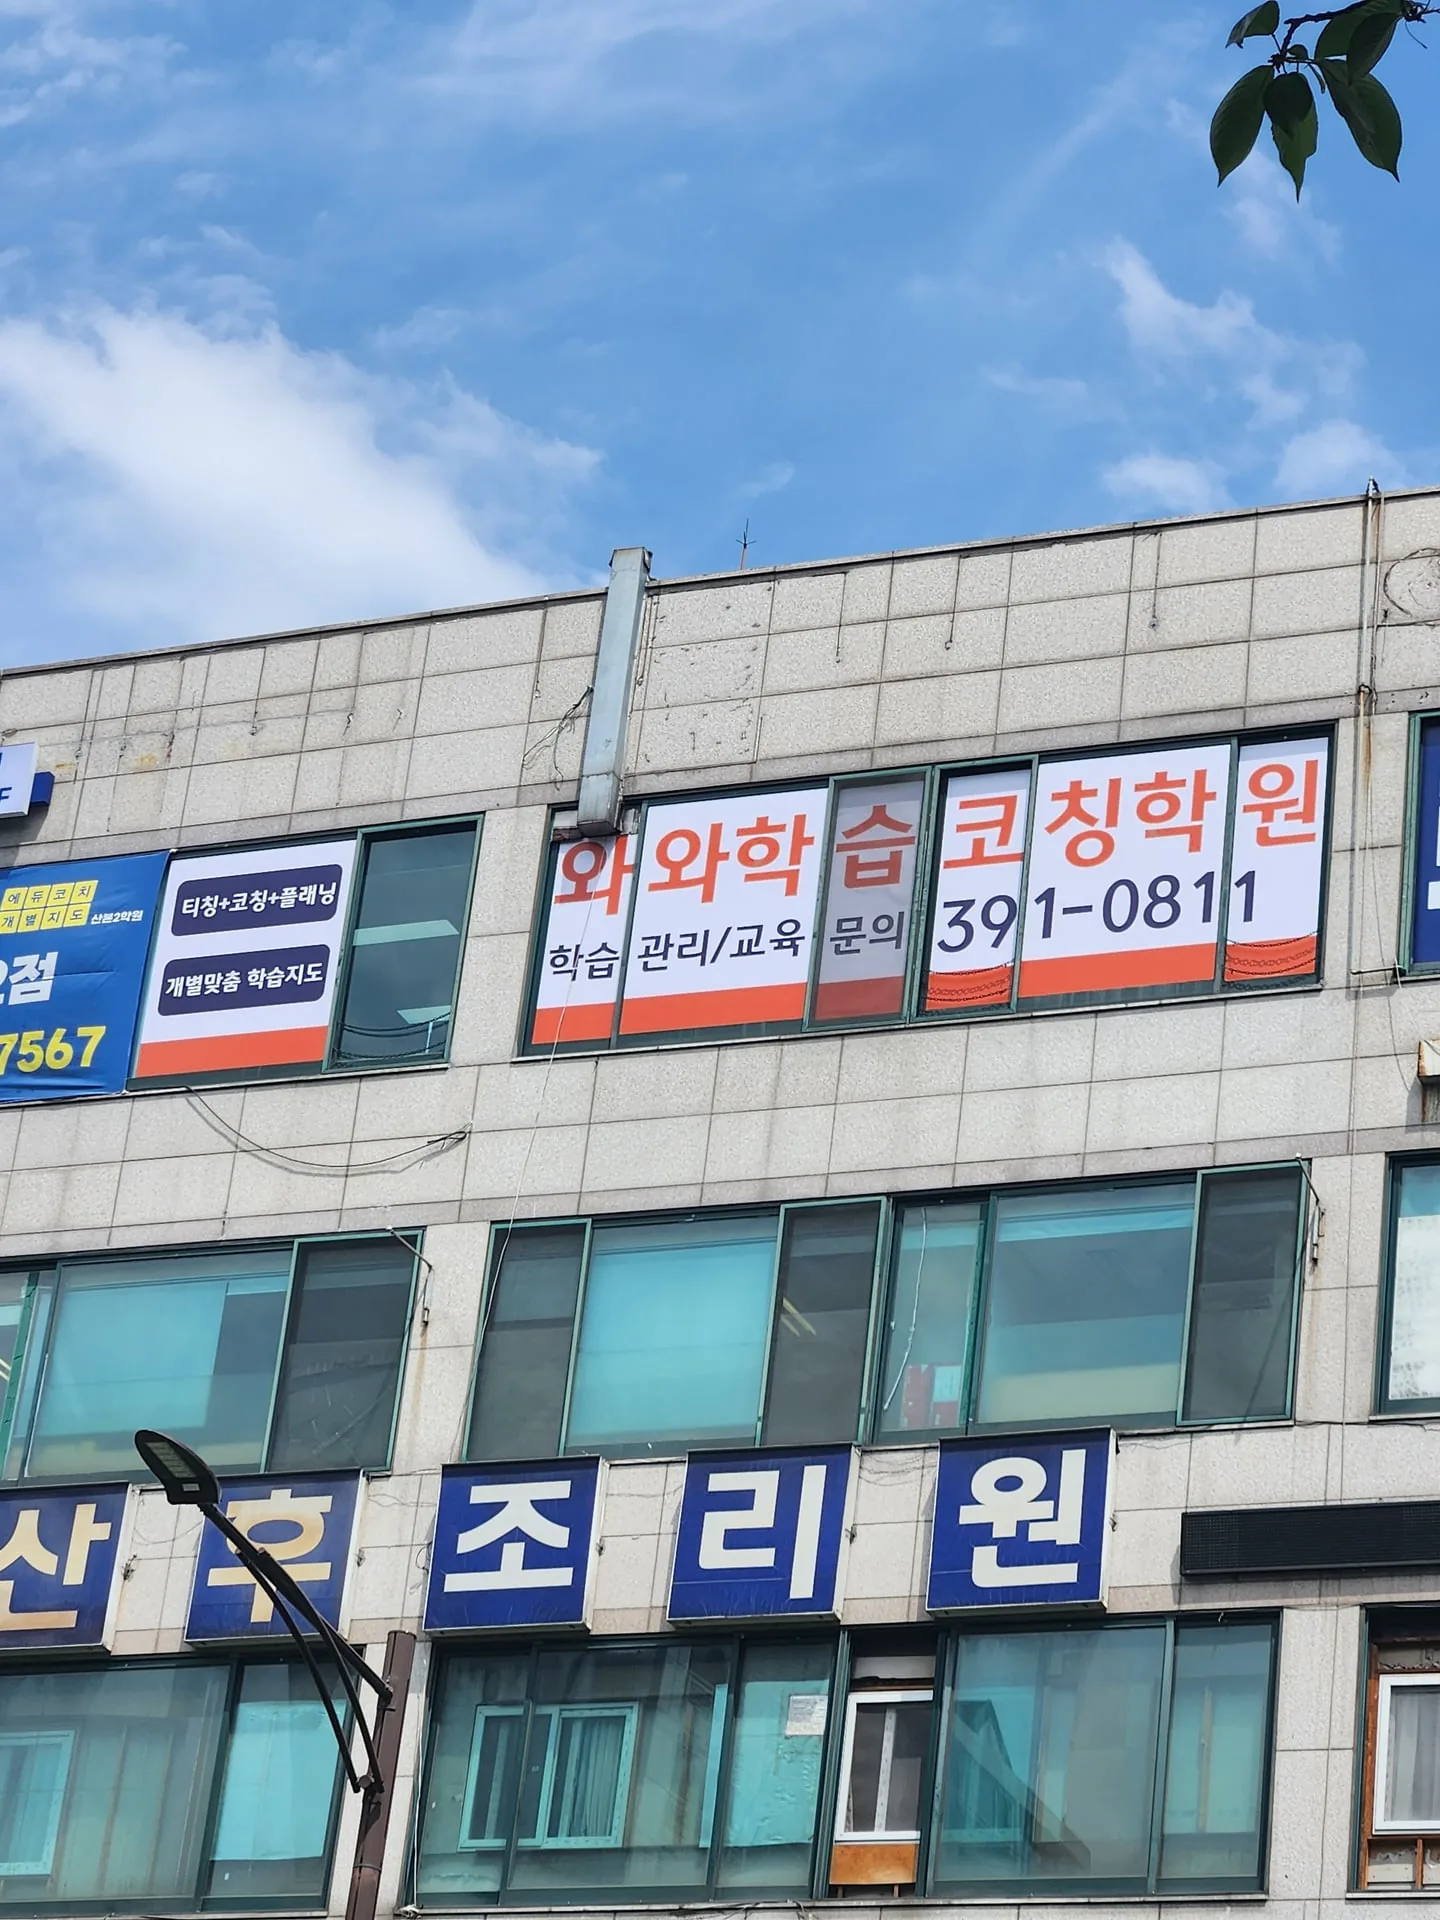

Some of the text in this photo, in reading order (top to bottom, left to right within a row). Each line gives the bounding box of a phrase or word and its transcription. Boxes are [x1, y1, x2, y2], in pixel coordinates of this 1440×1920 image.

[182, 882, 337, 918] 티칭+코칭+플래닝
[937, 870, 1256, 954] 391-0811
[165, 962, 324, 998] 개별맞춤 학습지도
